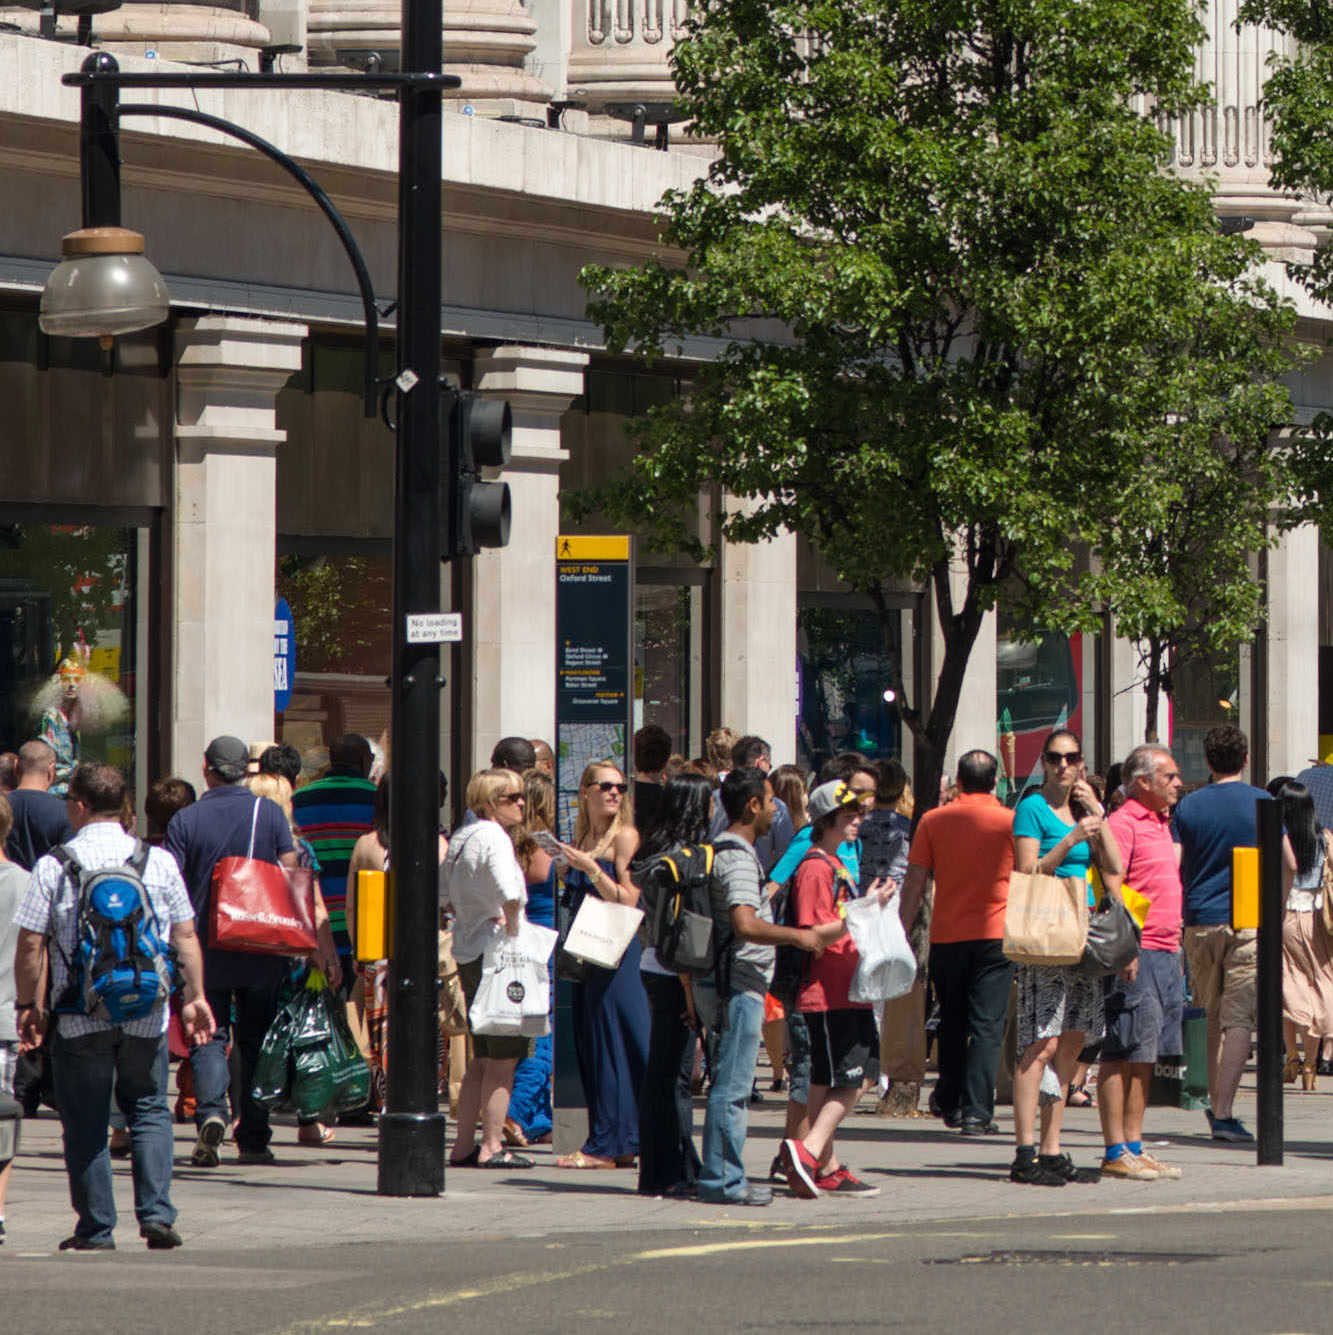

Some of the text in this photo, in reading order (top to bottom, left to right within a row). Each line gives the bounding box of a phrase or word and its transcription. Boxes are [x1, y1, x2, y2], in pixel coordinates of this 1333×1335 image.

[559, 566, 600, 574] WEST END
[559, 574, 612, 582] Oxford Street
[411, 618, 457, 628] No loading
[411, 628, 459, 639] at any time
